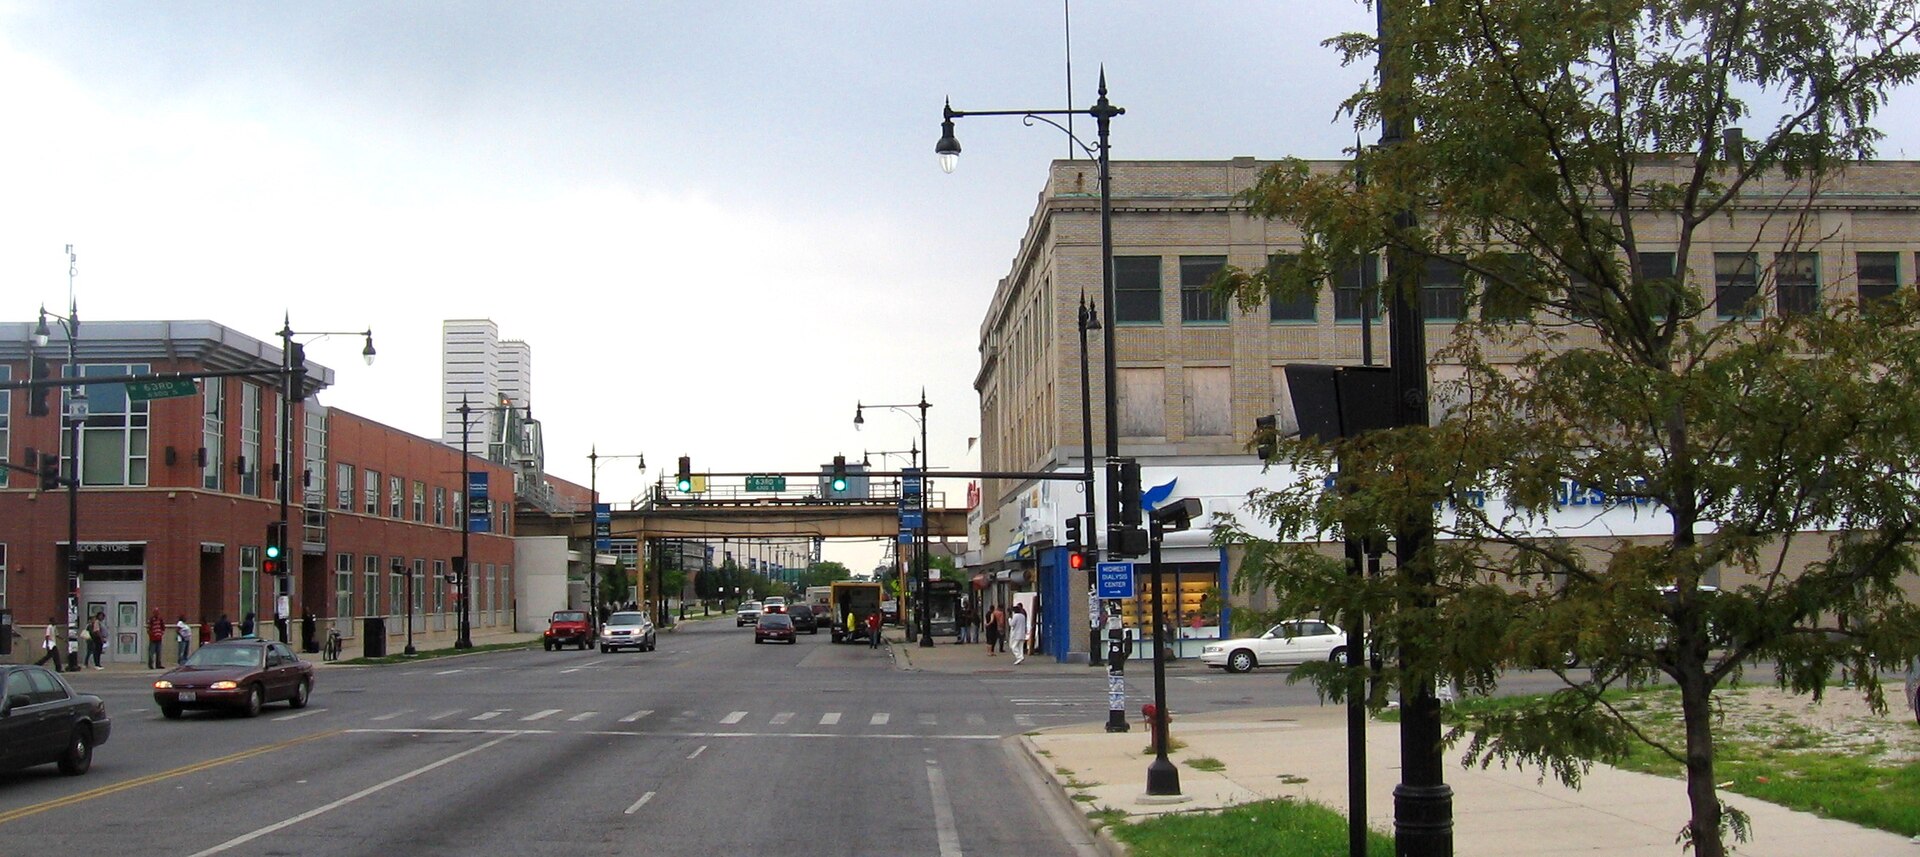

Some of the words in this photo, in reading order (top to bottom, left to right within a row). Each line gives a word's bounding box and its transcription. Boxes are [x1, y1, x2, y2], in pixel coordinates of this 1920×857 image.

[143, 381, 174, 392] 63RD
[755, 478, 774, 486] 63RD
[101, 543, 130, 552] STORE
